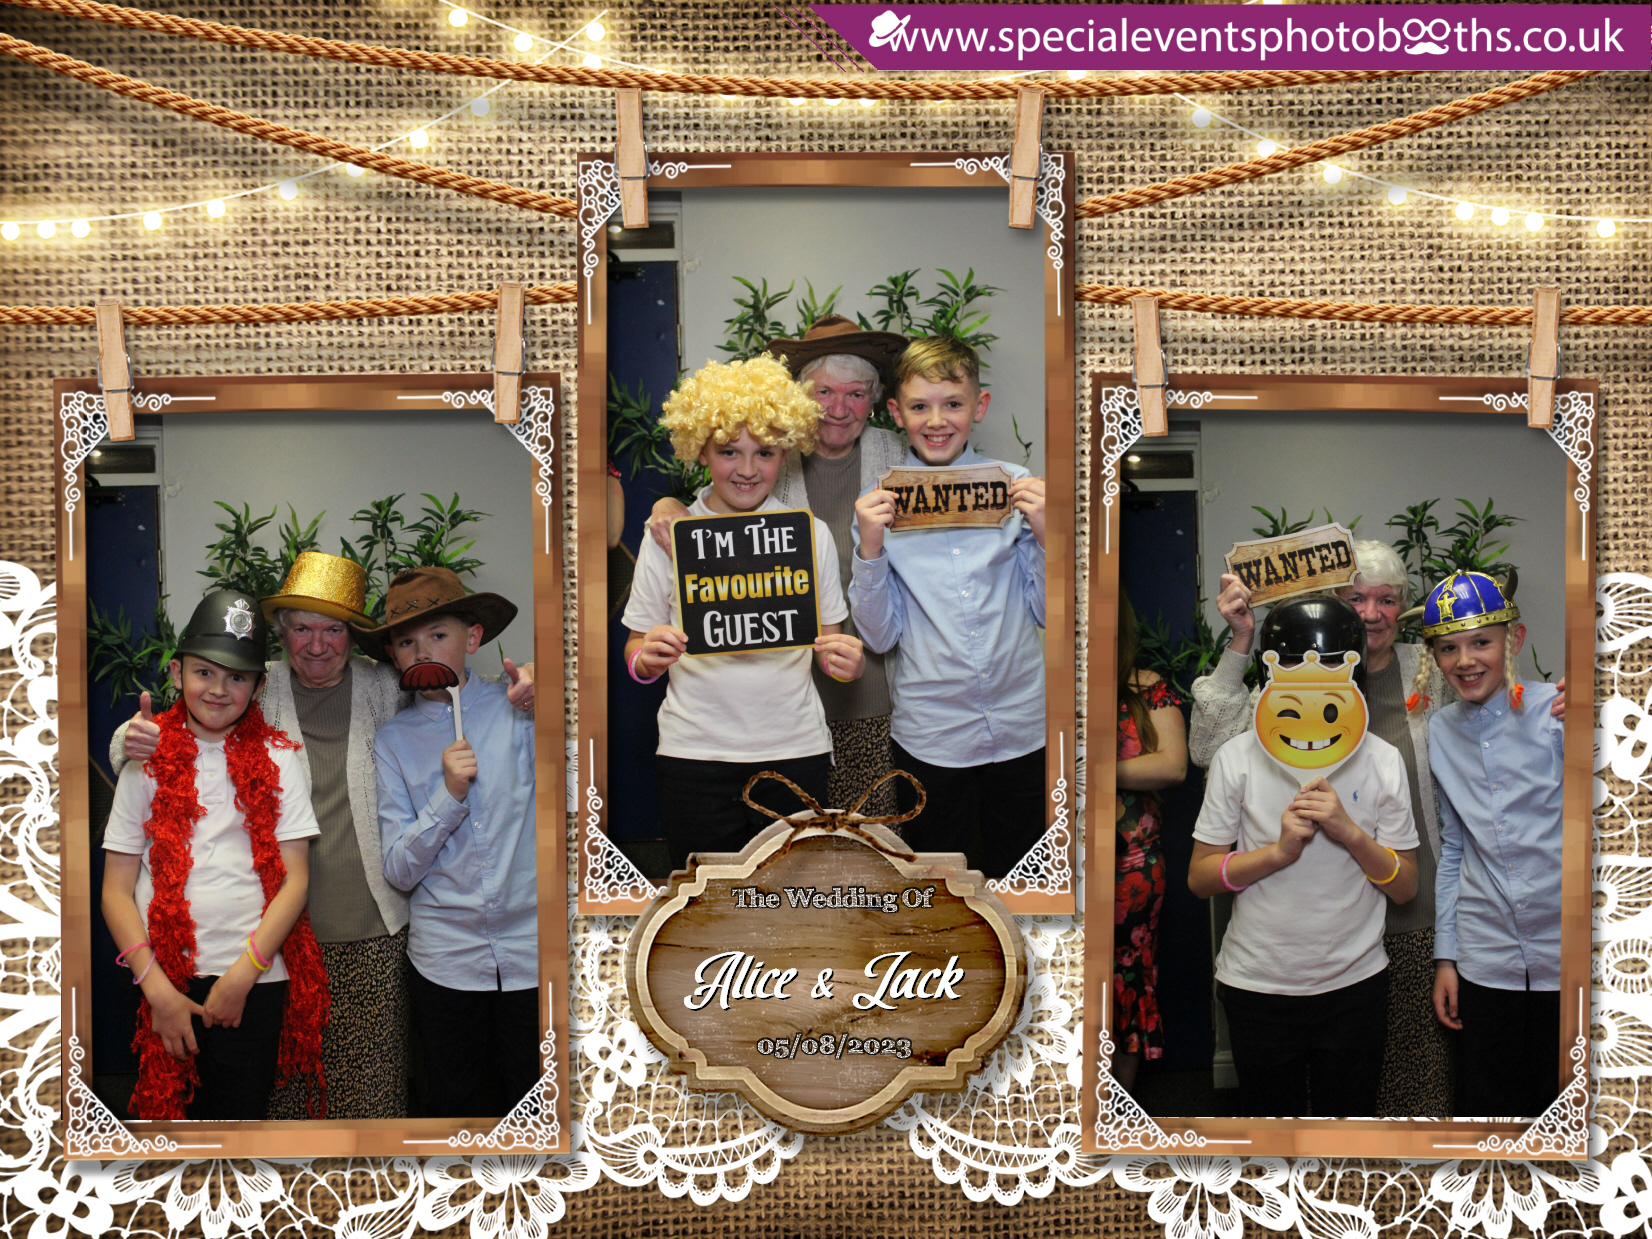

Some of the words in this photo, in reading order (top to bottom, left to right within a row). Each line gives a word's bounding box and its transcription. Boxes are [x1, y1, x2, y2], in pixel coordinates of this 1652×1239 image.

[884, 481, 1007, 514] WANTED
[744, 518, 797, 555] THE
[1233, 540, 1351, 588] WANTED
[685, 566, 810, 604] Favourite
[703, 609, 799, 648] GUEST
